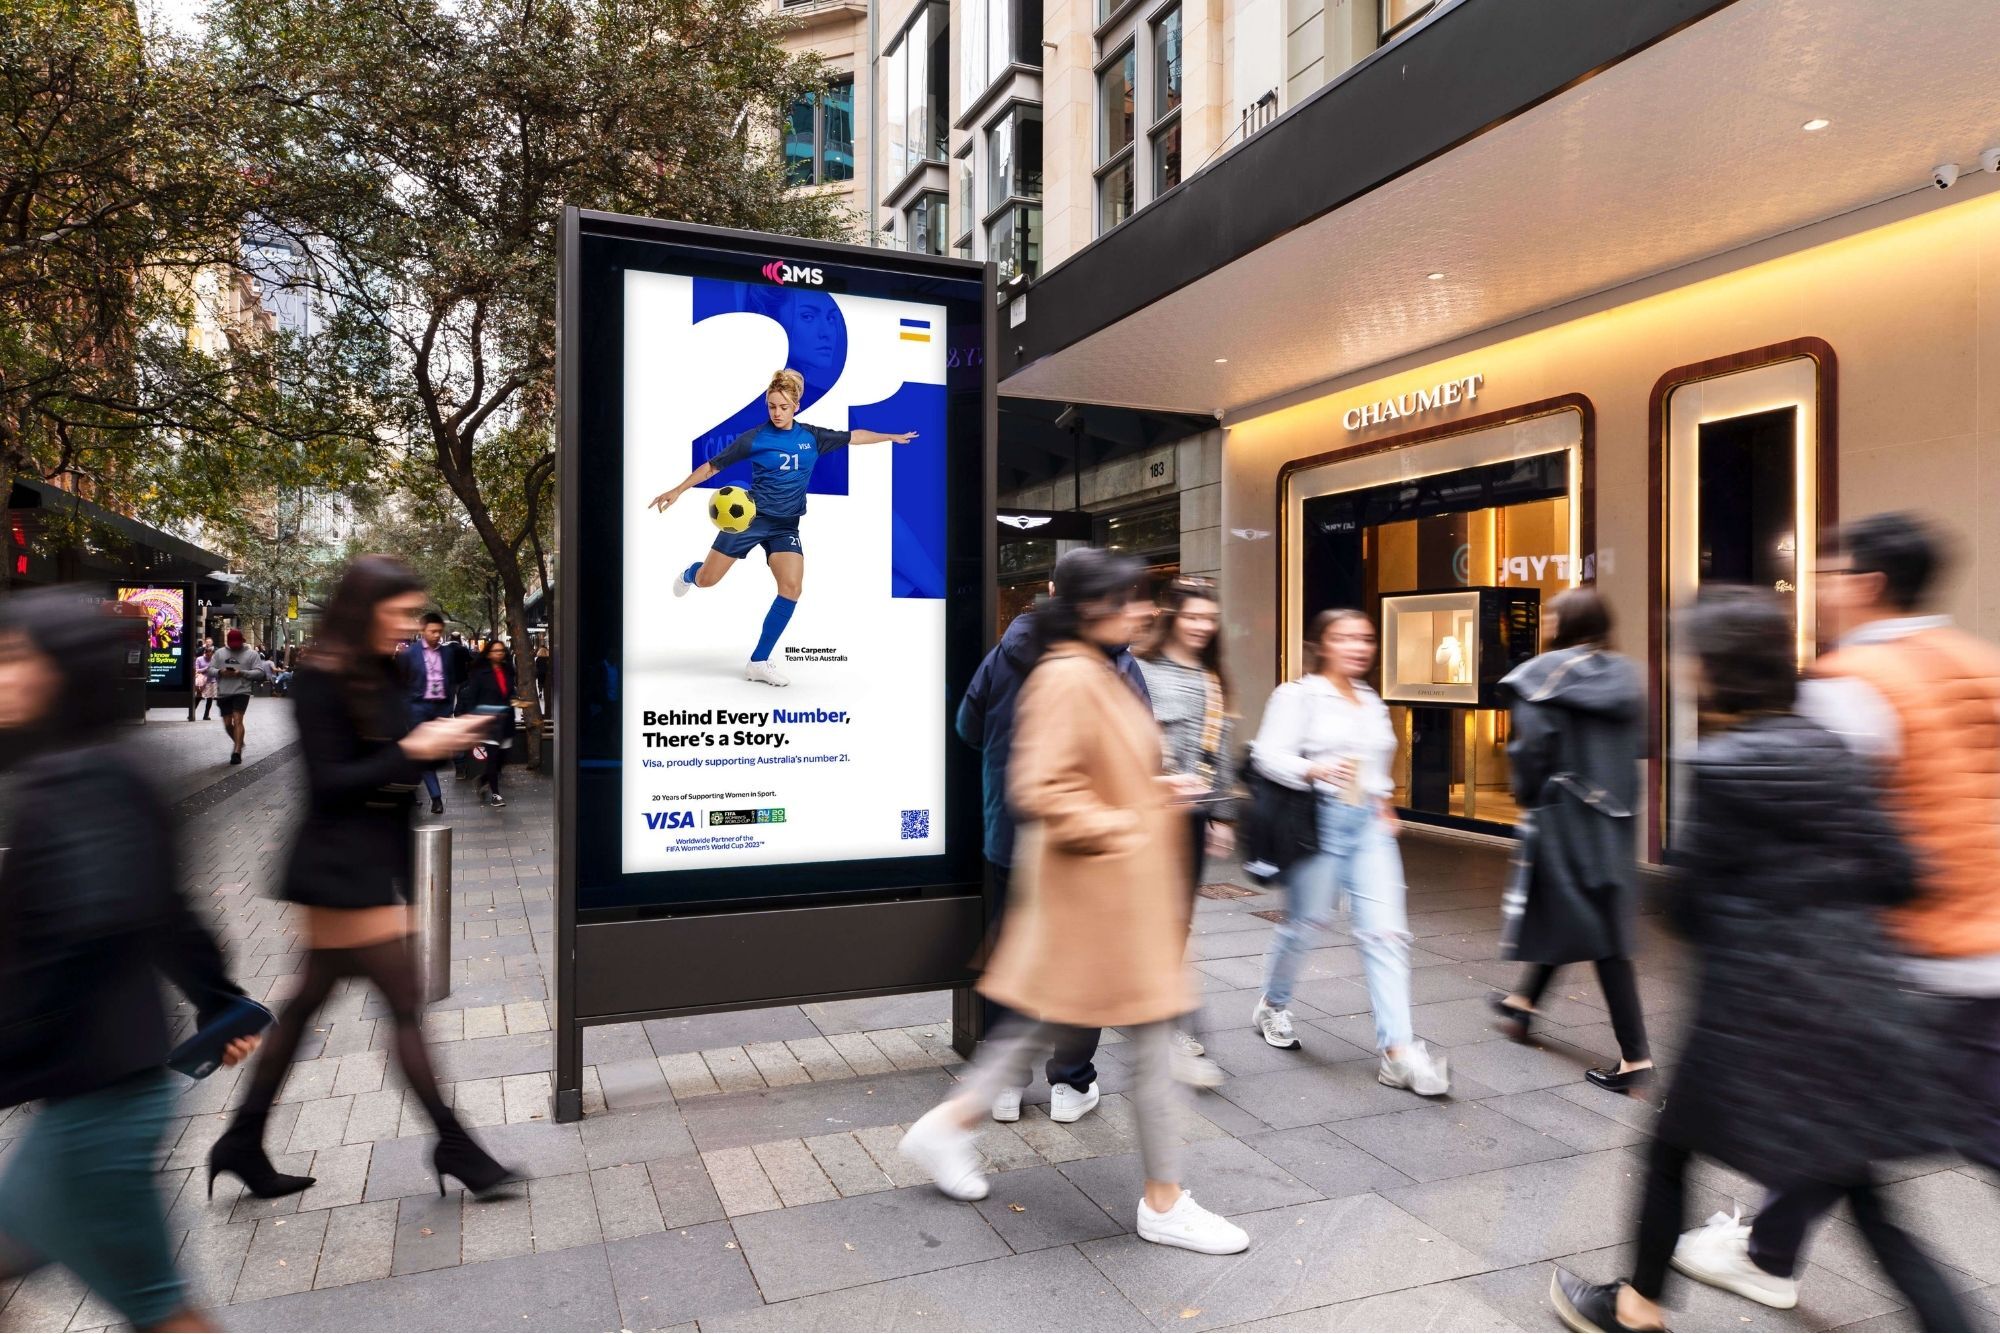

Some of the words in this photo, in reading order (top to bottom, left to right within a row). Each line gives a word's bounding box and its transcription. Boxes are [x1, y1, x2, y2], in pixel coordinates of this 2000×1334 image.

[780, 265, 824, 285] QMS
[1342, 373, 1486, 432] CHAUMET
[779, 453, 800, 471] 21
[1150, 462, 1164, 478] 183
[785, 646, 800, 654] Ellie
[801, 646, 837, 655] Carpenter
[785, 654, 804, 662] Team
[805, 654, 819, 662] Visa
[819, 654, 848, 662] Australia
[643, 710, 712, 726] Behind
[716, 709, 769, 728] Every
[772, 708, 851, 725] Number,
[643, 731, 714, 748] There's
[718, 734, 729, 747] a
[733, 731, 790, 748] Story.
[642, 758, 665, 769] Visa,
[666, 757, 703, 769] proudly
[704, 756, 756, 768] supporting
[756, 754, 802, 765] Australia's
[803, 754, 838, 764] number
[839, 753, 851, 763] 21.
[662, 793, 680, 801] Years
[688, 792, 725, 801] Supporting
[725, 791, 750, 799] Women
[757, 790, 777, 799] Sport.
[641, 811, 695, 830] VISA
[681, 844, 710, 852] Women's
[730, 842, 744, 850] Cup
[711, 836, 735, 844] Partner
